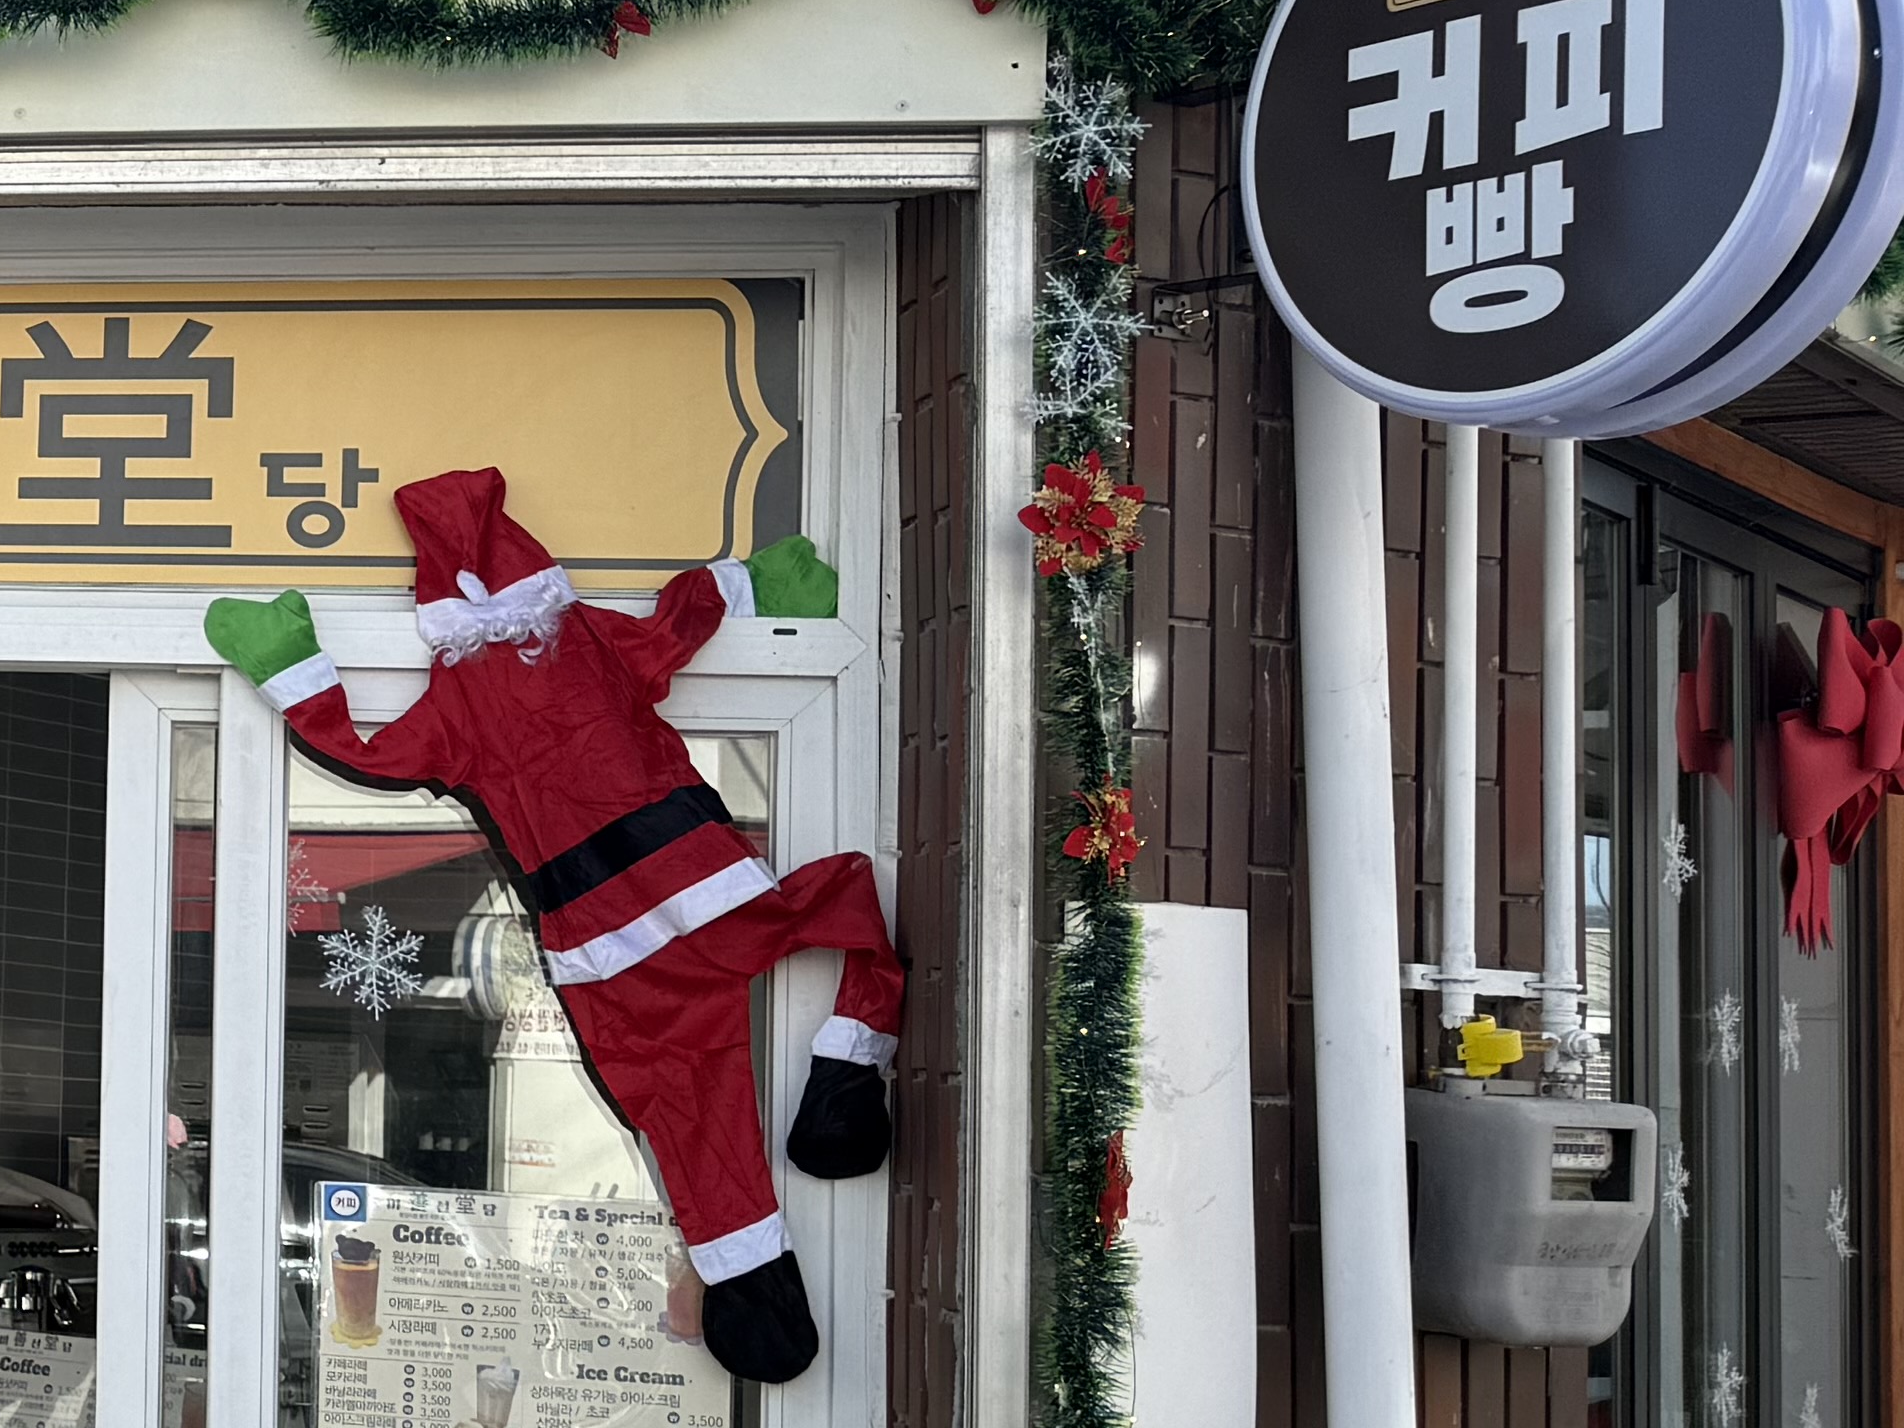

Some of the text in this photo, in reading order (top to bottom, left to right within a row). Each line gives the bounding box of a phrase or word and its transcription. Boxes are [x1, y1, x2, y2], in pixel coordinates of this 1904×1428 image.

[1425, 159, 1575, 334] 빵
[335, 1196, 357, 1208] 커피
[574, 1207, 589, 1221] &
[594, 1208, 663, 1227] Special
[392, 1224, 470, 1247] Coffee
[616, 1235, 652, 1247] 4,000
[485, 1258, 520, 1271] 1,500
[388, 1297, 517, 1318] 아메리카노 2,500
[388, 1320, 517, 1340] 시장라떼 2,500
[618, 1337, 654, 1350] 4,500
[0, 1356, 51, 1376] Coffee
[421, 1368, 452, 1379] 3,000
[576, 1364, 685, 1386] Ice Cream
[421, 1380, 452, 1392] 3,500
[421, 1394, 451, 1406] 3,500
[581, 1388, 617, 1404] 유기농
[620, 1392, 681, 1409] 아이스크림
[420, 1407, 451, 1419] 3,500
[687, 1415, 724, 1428] 3,500
